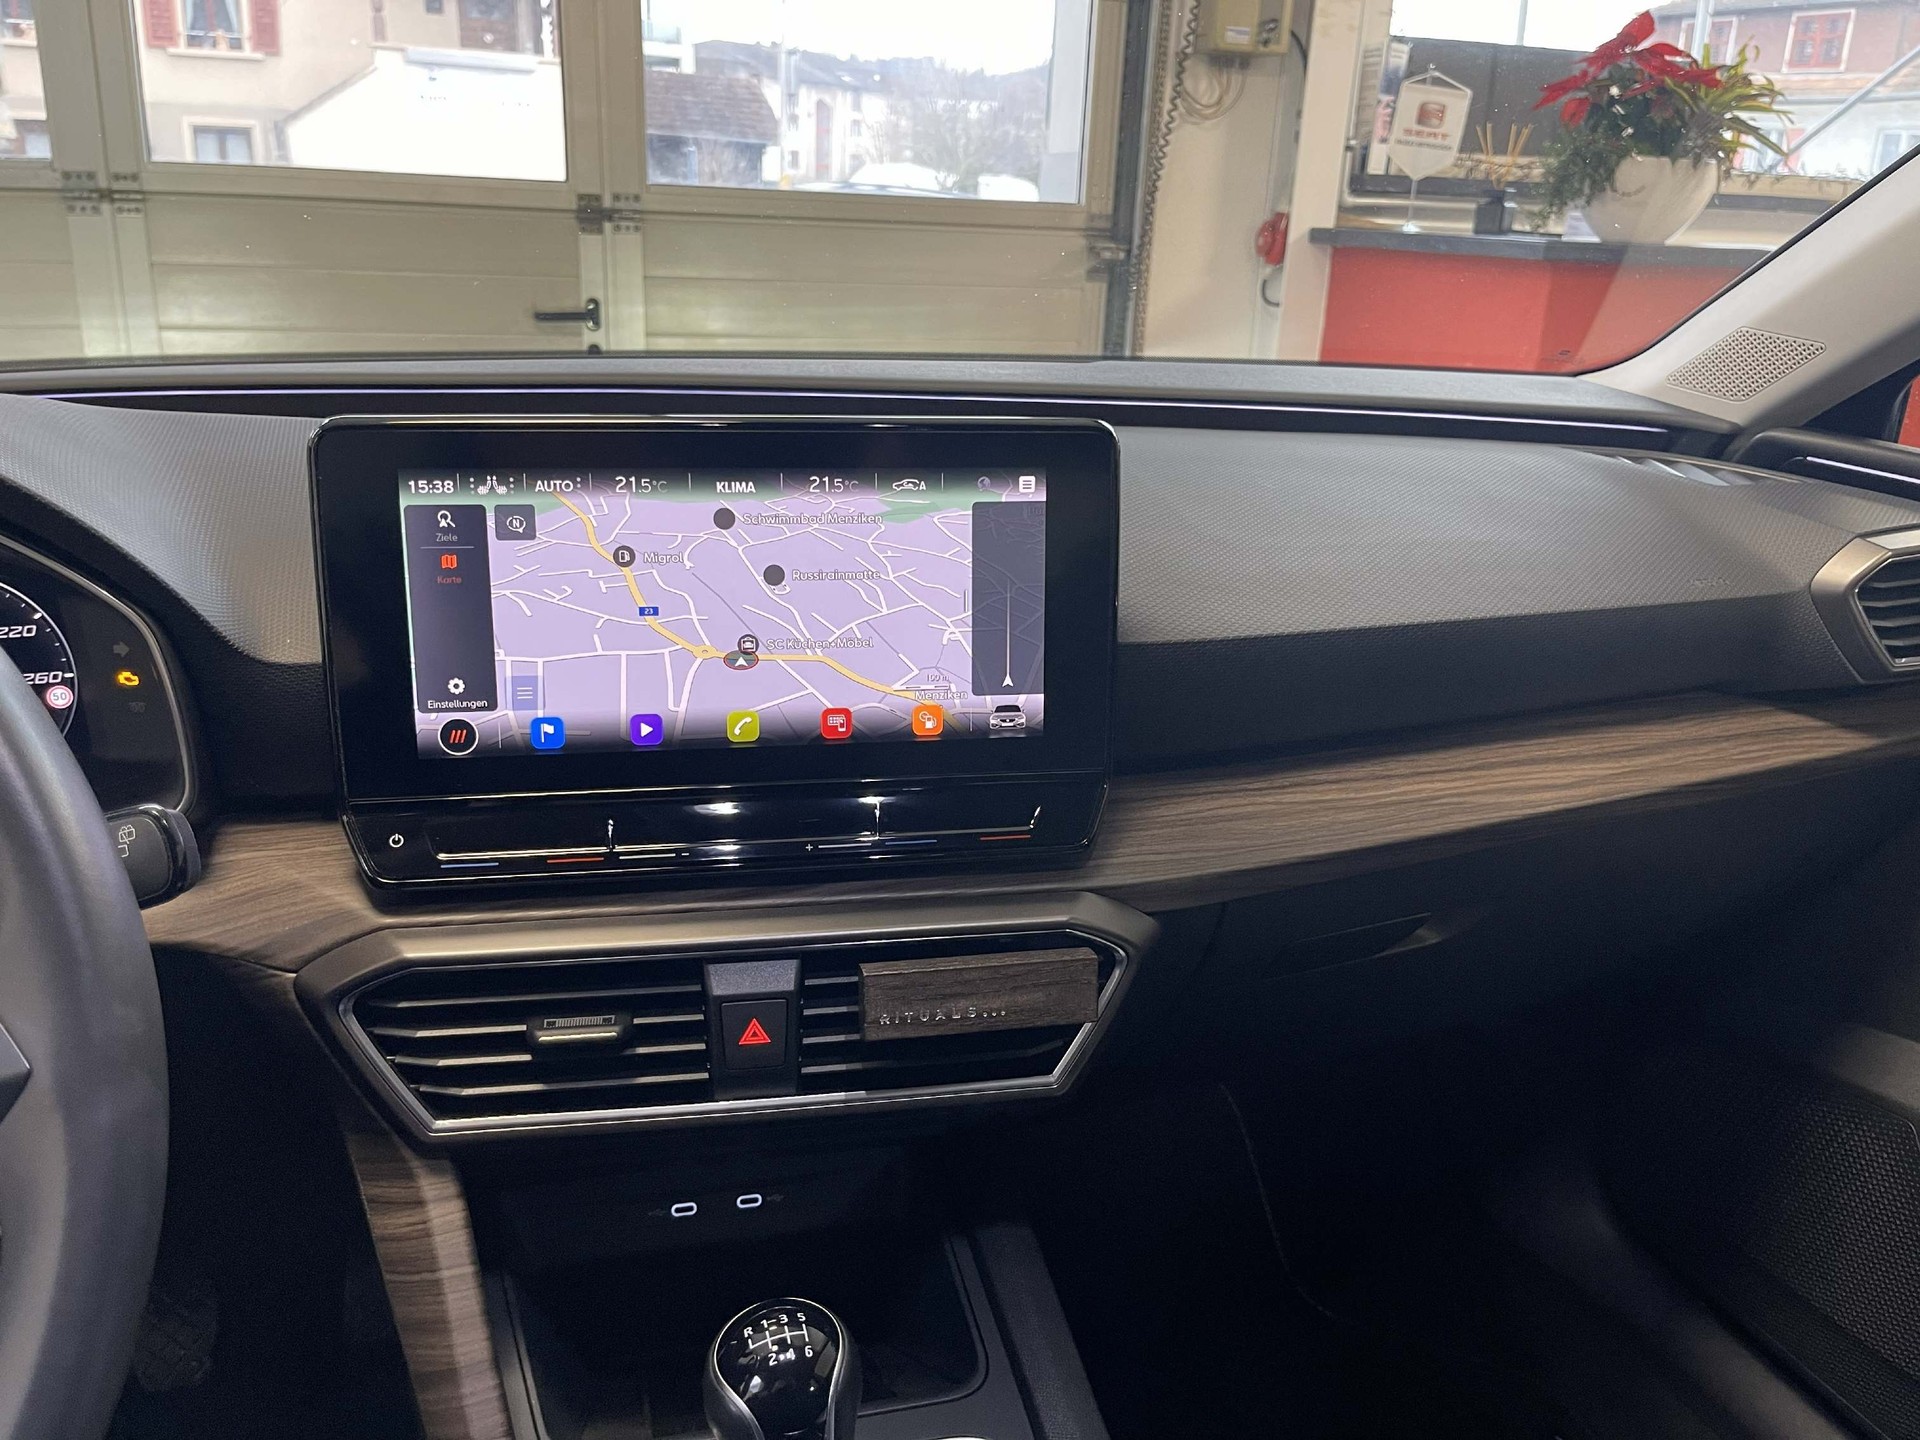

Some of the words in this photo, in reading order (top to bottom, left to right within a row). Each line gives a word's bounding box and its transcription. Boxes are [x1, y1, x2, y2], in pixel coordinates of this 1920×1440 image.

[408, 480, 454, 494] 15:38
[535, 480, 574, 492] AUTO
[716, 481, 756, 493] KLIMA
[743, 513, 824, 525] Schwimmbad
[827, 512, 883, 524] Menziken
[436, 533, 458, 542] Ziele
[644, 552, 684, 565] Migrol
[437, 575, 461, 584] Karte
[792, 569, 880, 580] Russirainmatte
[0, 625, 37, 639] 220
[767, 640, 784, 650] SC
[23, 671, 63, 685] 260
[52, 692, 68, 701] 50
[915, 690, 968, 701] Menziken
[427, 700, 488, 709] Einstellungen
[744, 1327, 753, 1337] R
[760, 1319, 768, 1328] 1
[779, 1314, 788, 1323] 3
[797, 1313, 806, 1321] 5
[768, 1353, 778, 1366] 2
[786, 1348, 796, 1360] 4
[804, 1345, 813, 1358] 6
